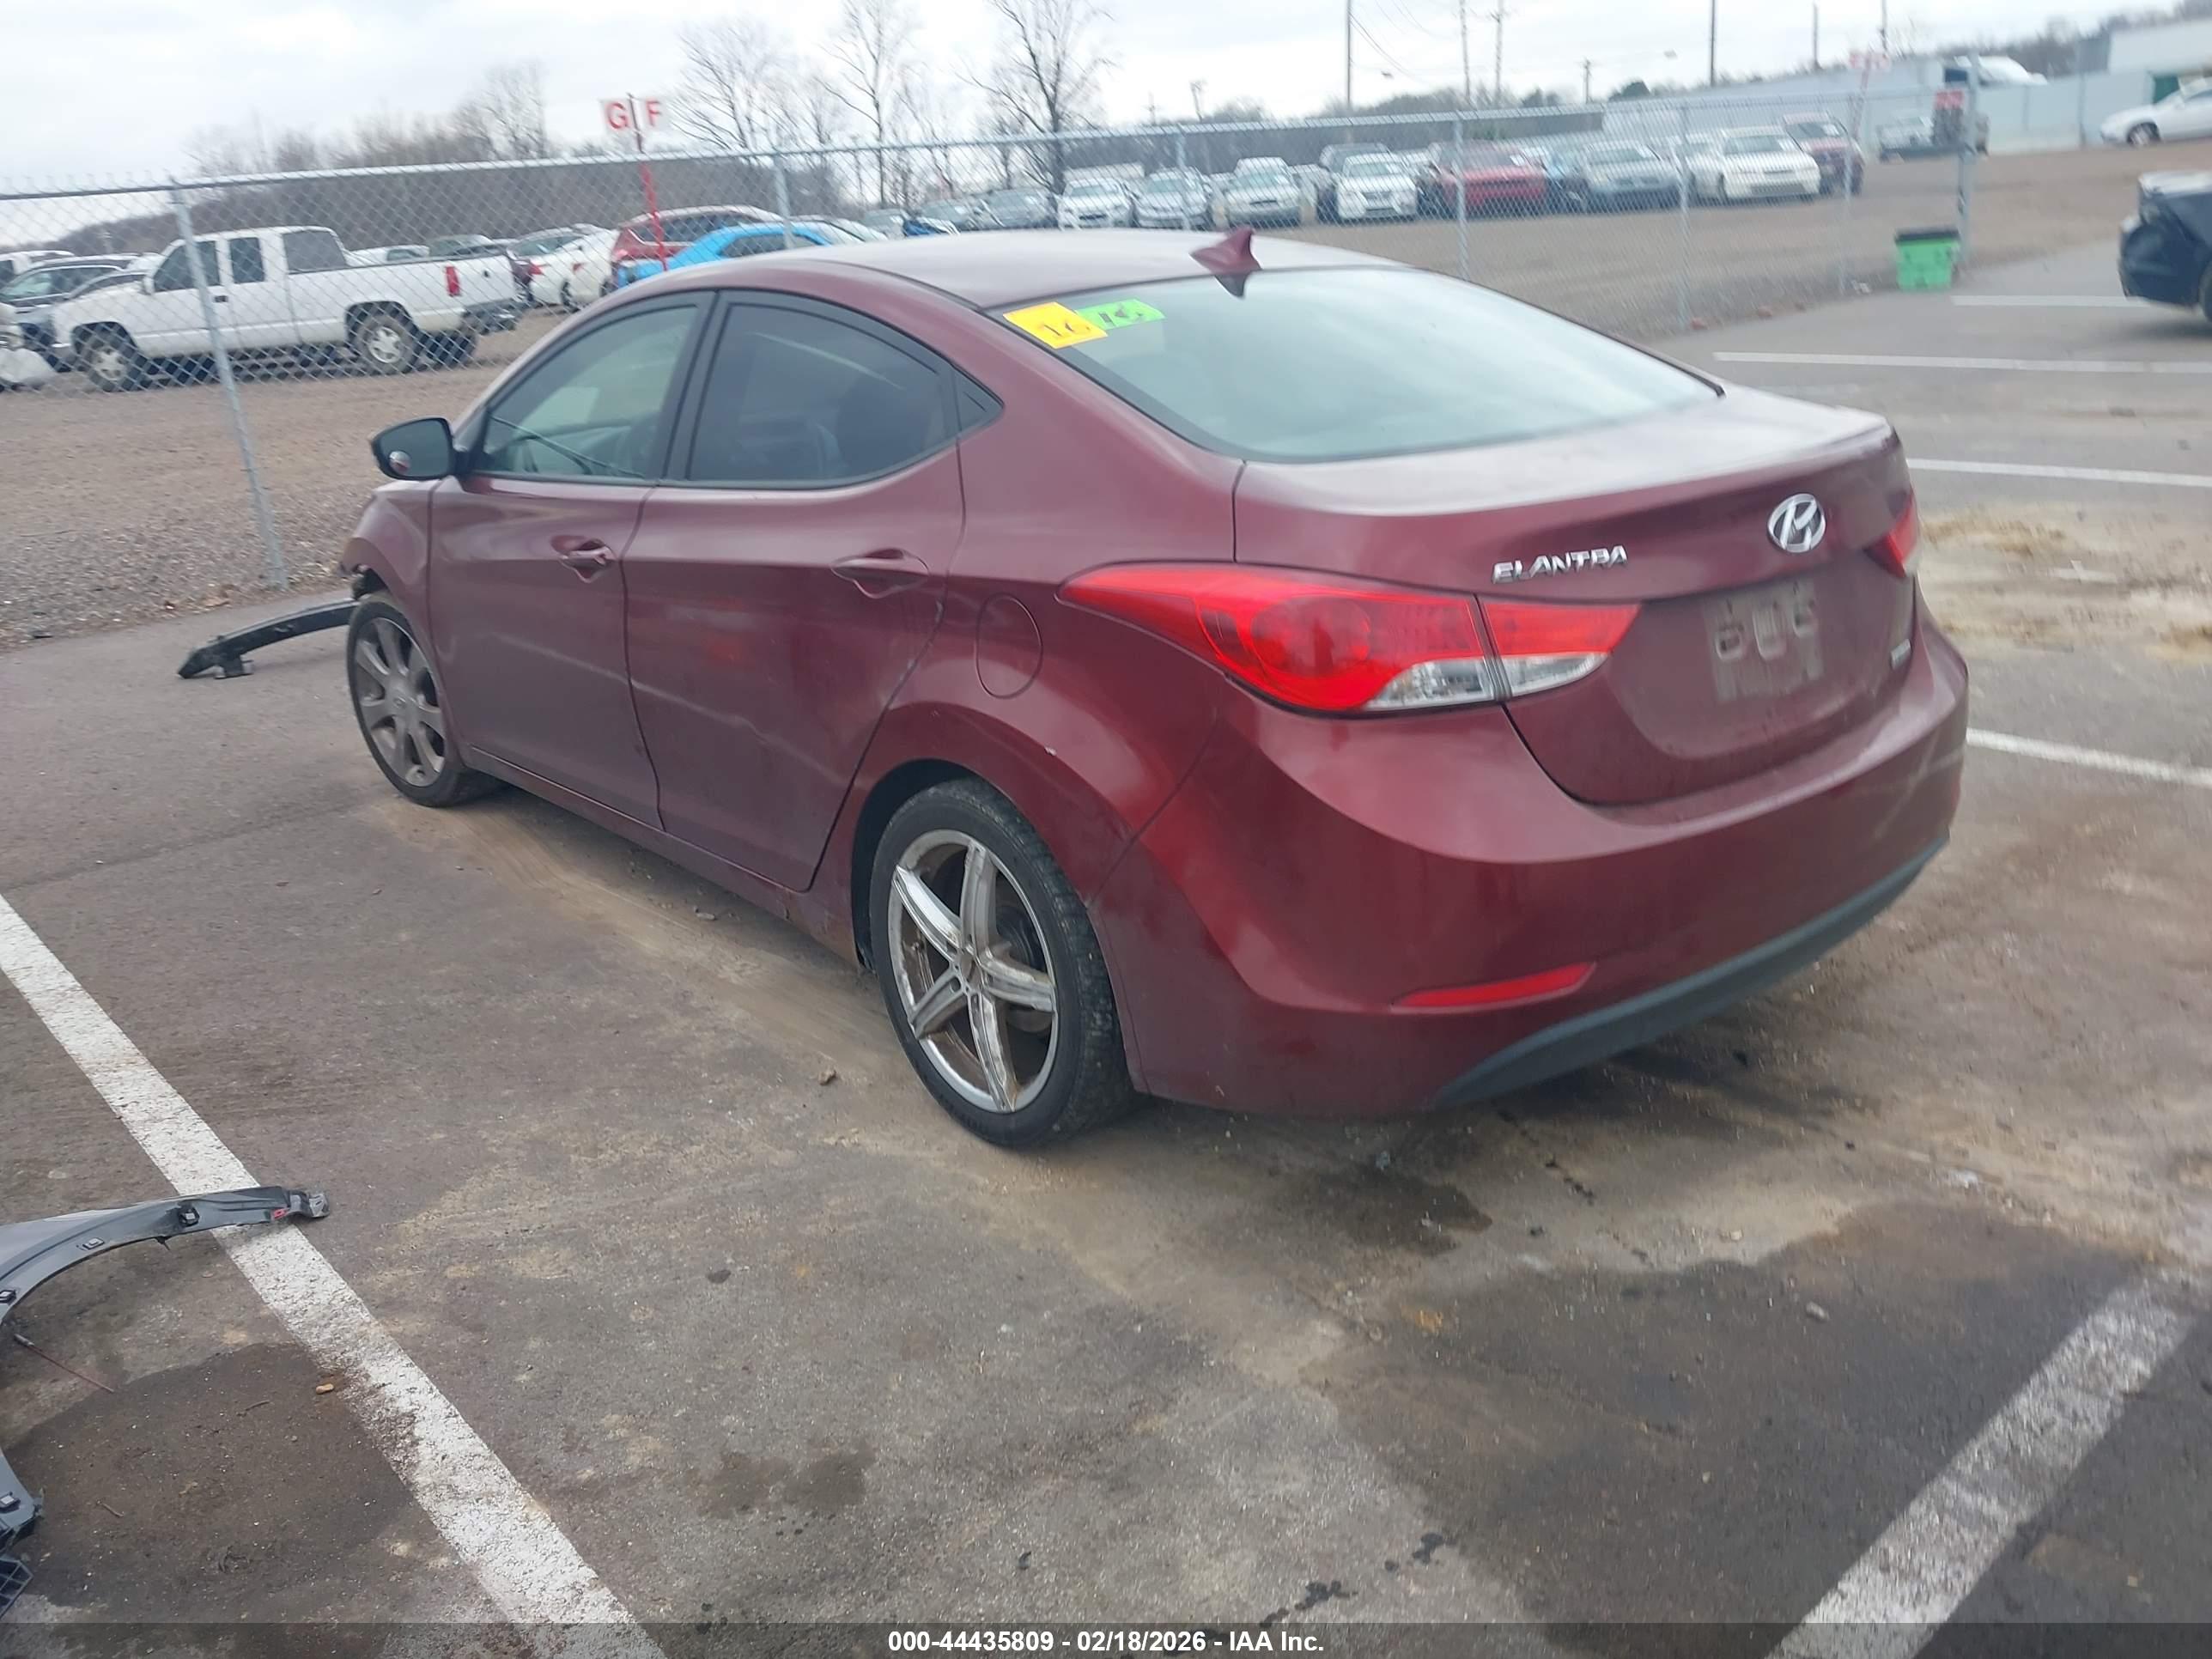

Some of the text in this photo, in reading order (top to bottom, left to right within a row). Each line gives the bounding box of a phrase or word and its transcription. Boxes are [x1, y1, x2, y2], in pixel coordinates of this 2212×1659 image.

[605, 98, 662, 130] G F
[1492, 544, 1628, 585] ELANTRA
